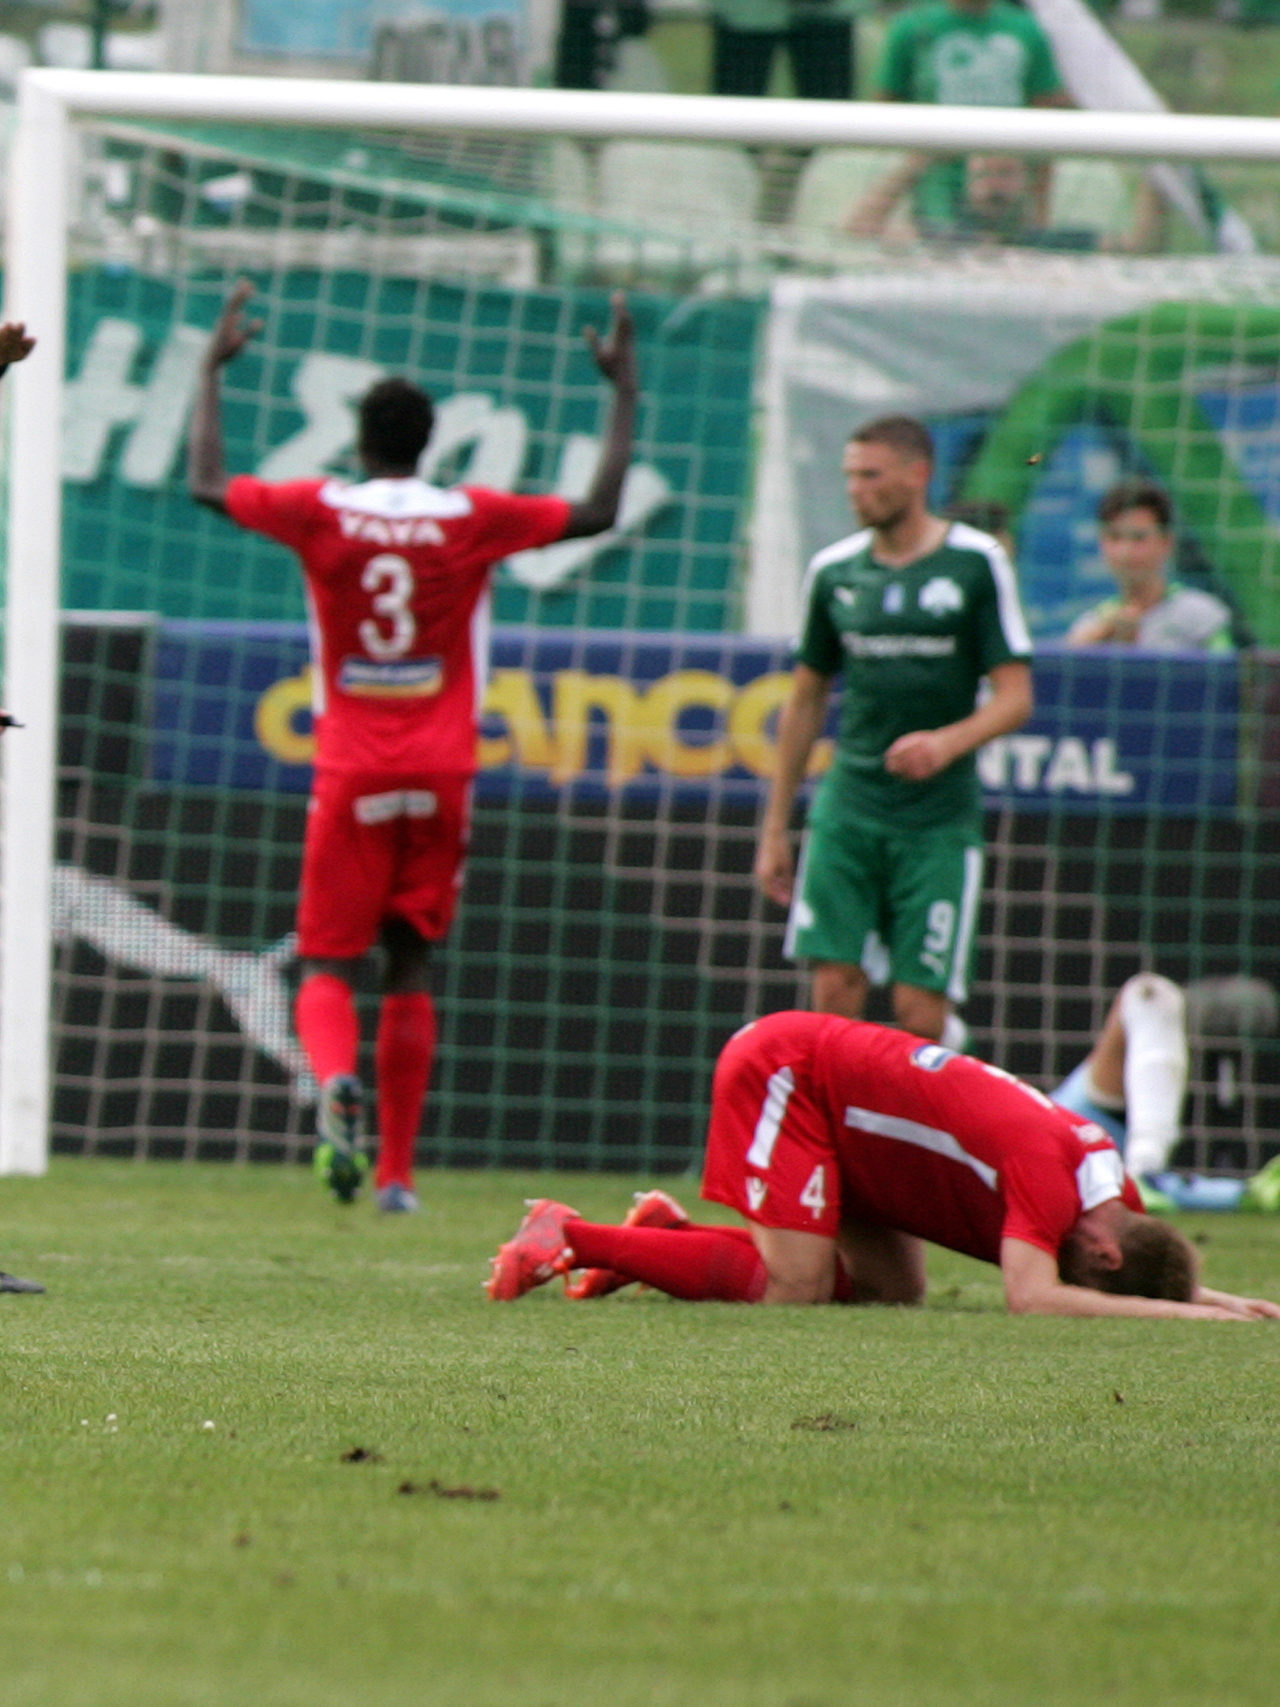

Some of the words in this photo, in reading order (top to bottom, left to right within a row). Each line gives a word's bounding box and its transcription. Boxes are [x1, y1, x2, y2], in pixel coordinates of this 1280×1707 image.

[358, 552, 417, 663] 3
[923, 899, 955, 953] 9
[799, 1163, 827, 1220] 4
